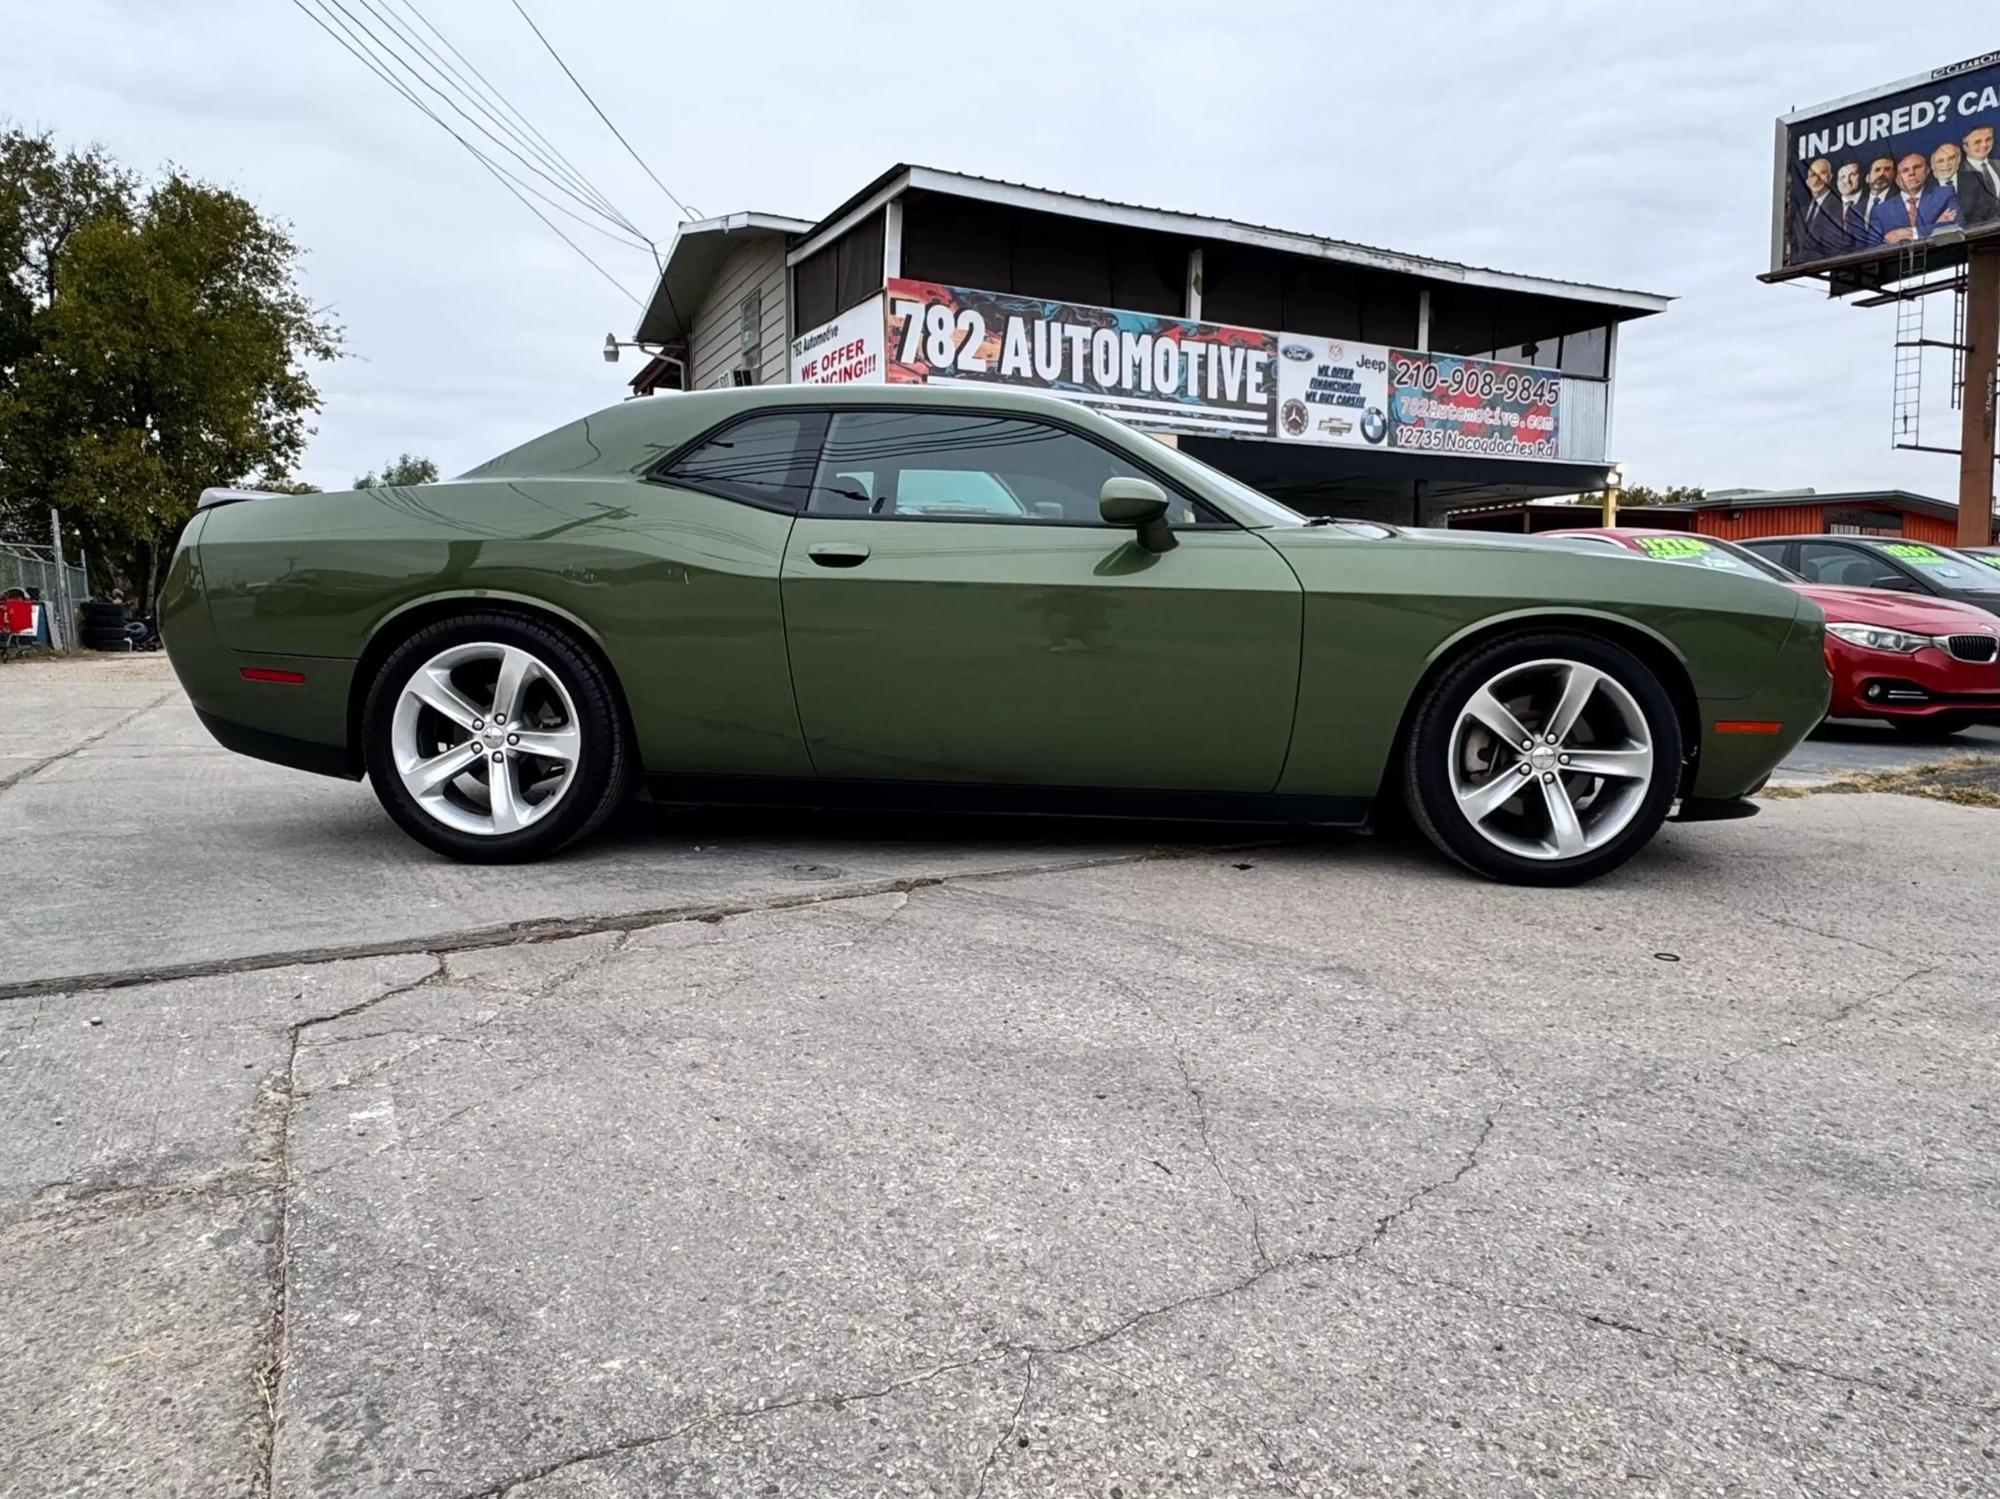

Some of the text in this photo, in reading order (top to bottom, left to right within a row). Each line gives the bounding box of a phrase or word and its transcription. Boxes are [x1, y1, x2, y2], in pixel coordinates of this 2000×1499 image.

[1798, 85, 2000, 160] INJURED? CA
[803, 324, 839, 352] Automotive
[893, 300, 1268, 405] 782 AUTOMOTIVE
[802, 338, 865, 382] WE OFFER
[1317, 364, 1354, 380] WE OFFER
[1356, 354, 1386, 373] Jeep
[1305, 390, 1318, 403] WE
[1395, 360, 1560, 406] 210-908-9845
[1400, 396, 1554, 431] 782Automotive.com
[1397, 426, 1443, 448] 12735
[1536, 440, 1555, 457] Rd
